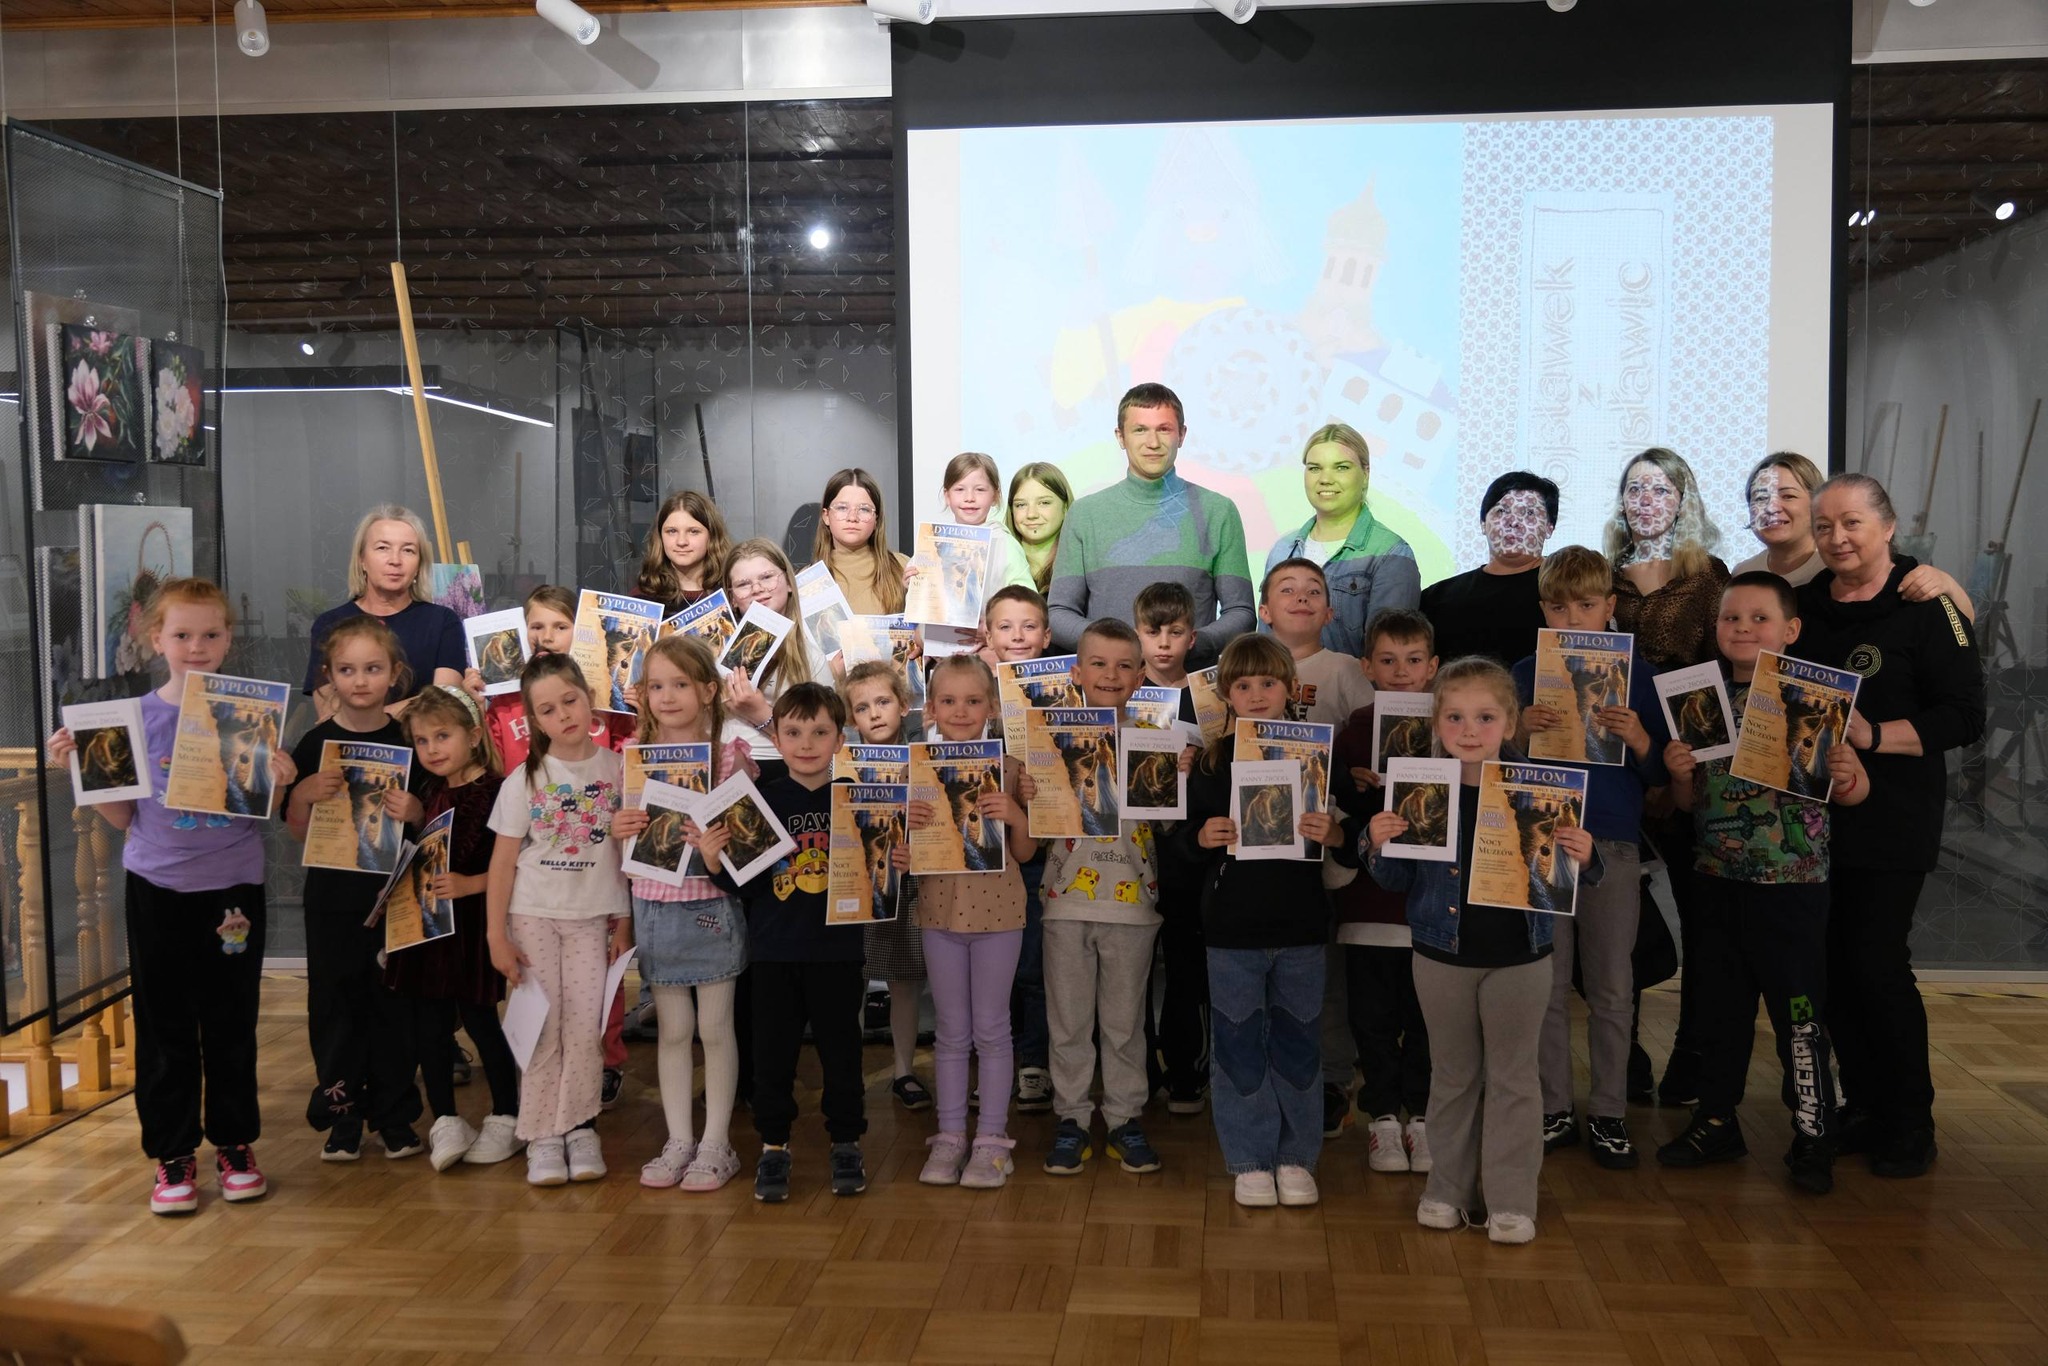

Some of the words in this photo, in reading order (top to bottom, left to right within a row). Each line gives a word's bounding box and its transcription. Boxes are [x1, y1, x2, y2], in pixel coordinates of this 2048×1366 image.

[1605, 260, 1654, 460] jsławic
[1534, 256, 1580, 495] ojsławek
[933, 525, 979, 538] DYPLOM
[598, 596, 648, 614] DYPLOM
[670, 600, 714, 629] DYPLOM
[1559, 633, 1614, 648] DYPLOM
[1016, 660, 1066, 675] DYPLOM
[1779, 660, 1840, 685] DYPLOM
[208, 678, 269, 697] DYPLOM
[1132, 690, 1164, 700] PLOM
[1045, 712, 1099, 723] DYPLOM
[1746, 718, 1769, 731] NOCY
[1257, 723, 1314, 739] DYPLOM
[341, 745, 395, 761] DYPLOM
[642, 748, 694, 760] DYPLOM
[852, 748, 901, 759] DYPLOM
[929, 744, 985, 757] DYPLOM
[1505, 767, 1567, 784] DYPLOM
[849, 788, 894, 799] DYPLOM
[788, 813, 830, 835] PAW
[1479, 836, 1502, 846] NOCY
[540, 859, 567, 867] HELLO
[568, 860, 597, 868] KITTY
